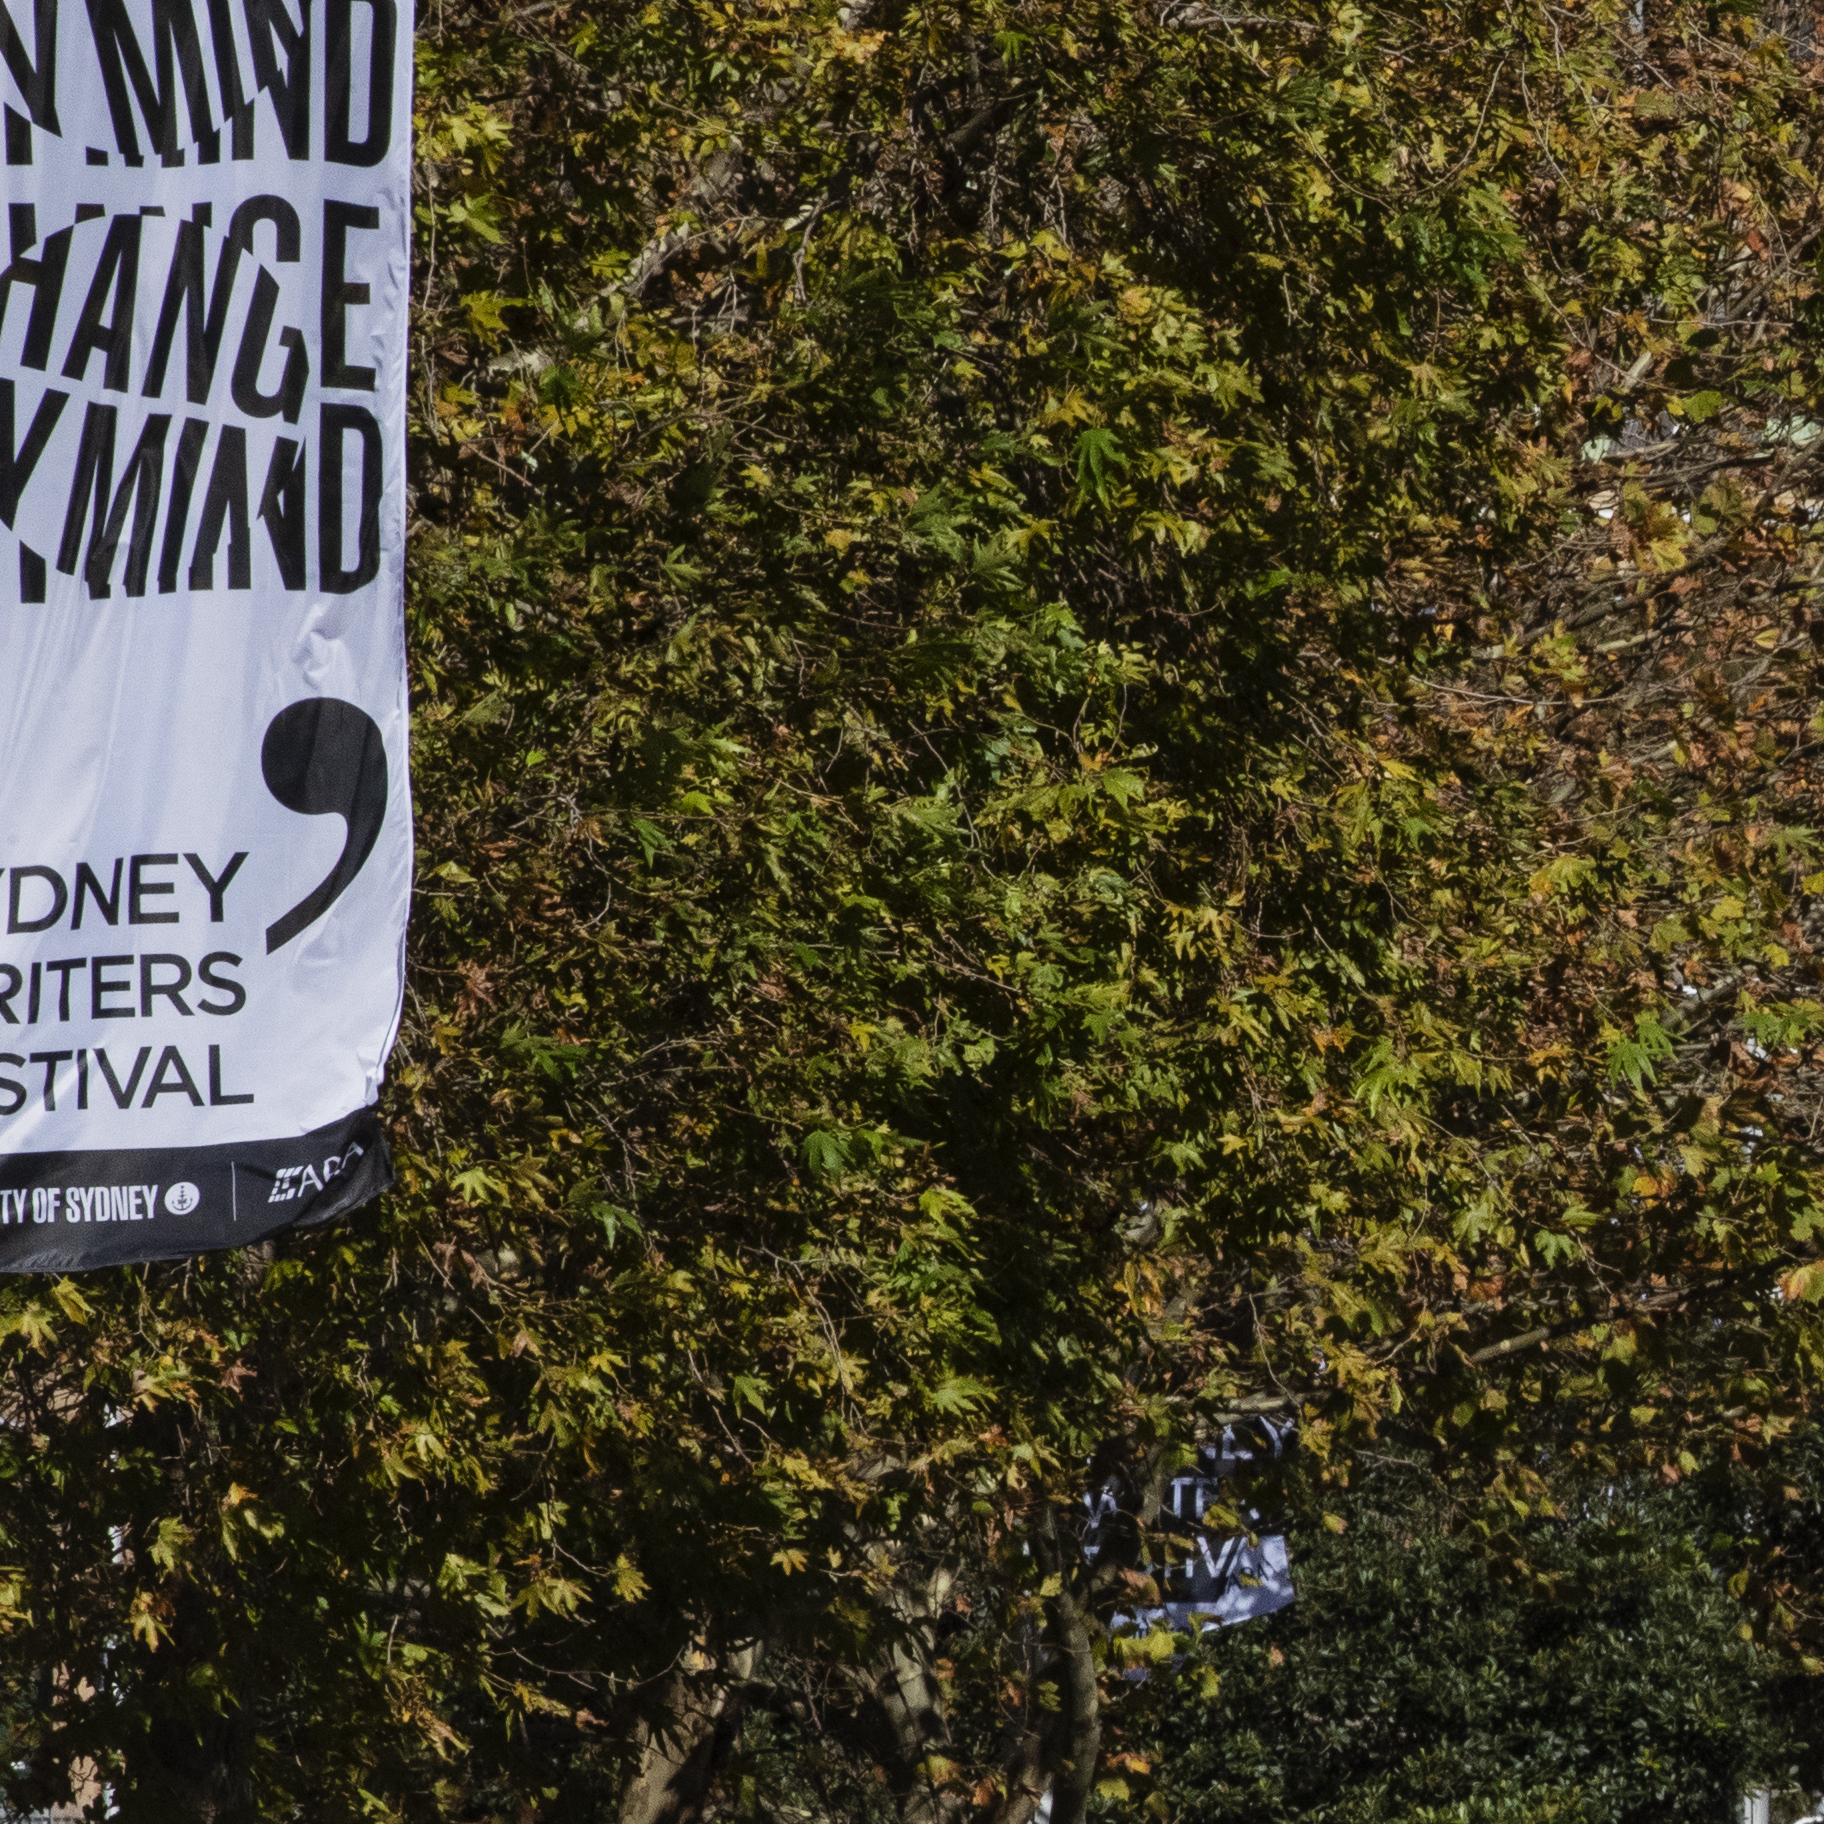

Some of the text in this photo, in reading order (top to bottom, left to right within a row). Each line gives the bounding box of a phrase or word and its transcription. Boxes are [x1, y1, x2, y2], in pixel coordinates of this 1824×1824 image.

[86, 0, 397, 168] MIND
[56, 400, 383, 600] MIND
[0, 852, 250, 935] DNEY
[32, 1187, 61, 1223] OF
[65, 1184, 159, 1223] SYDNEY
